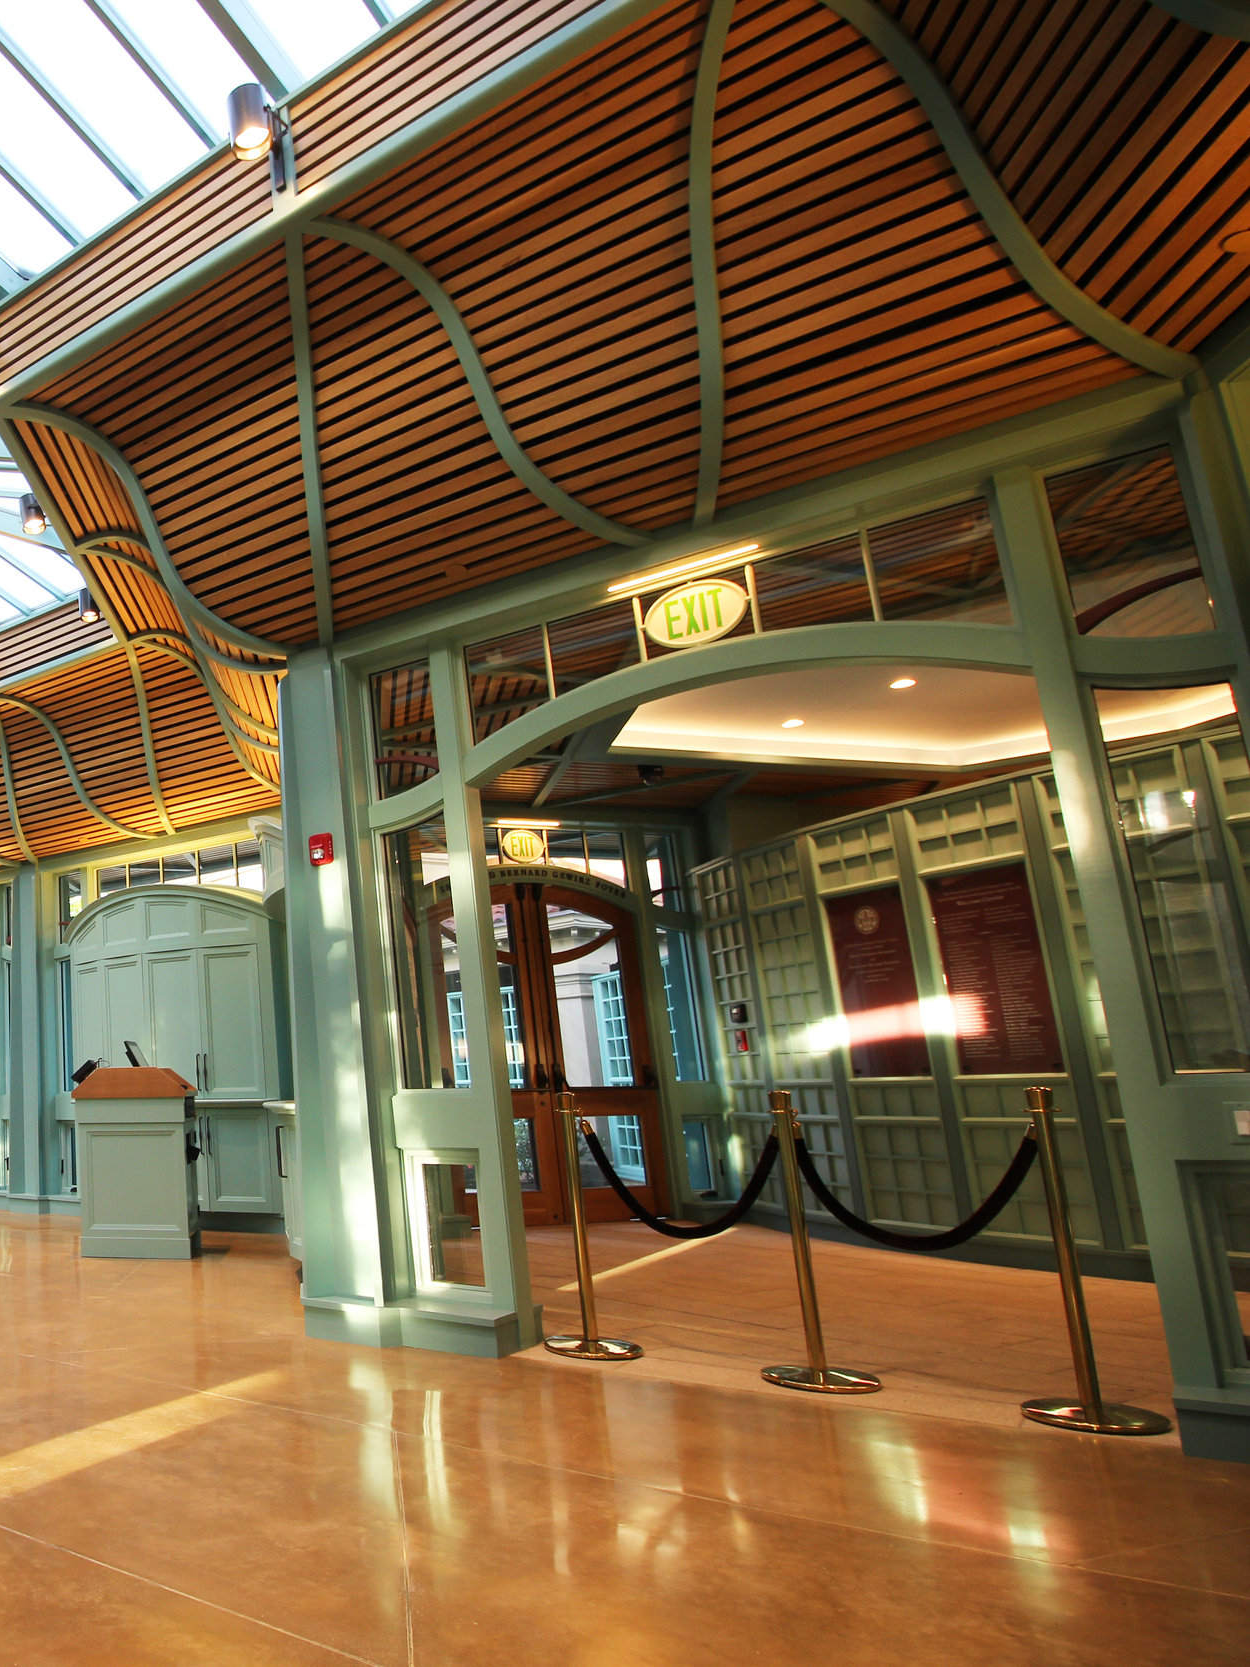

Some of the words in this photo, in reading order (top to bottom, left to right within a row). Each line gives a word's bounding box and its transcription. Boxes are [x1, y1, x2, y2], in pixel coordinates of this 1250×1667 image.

[664, 588, 723, 640] EXIT
[511, 836, 535, 857] EXIT
[500, 868, 548, 878] BERNARD
[552, 869, 592, 886] GEWIRZ
[595, 881, 627, 899] FOYER
